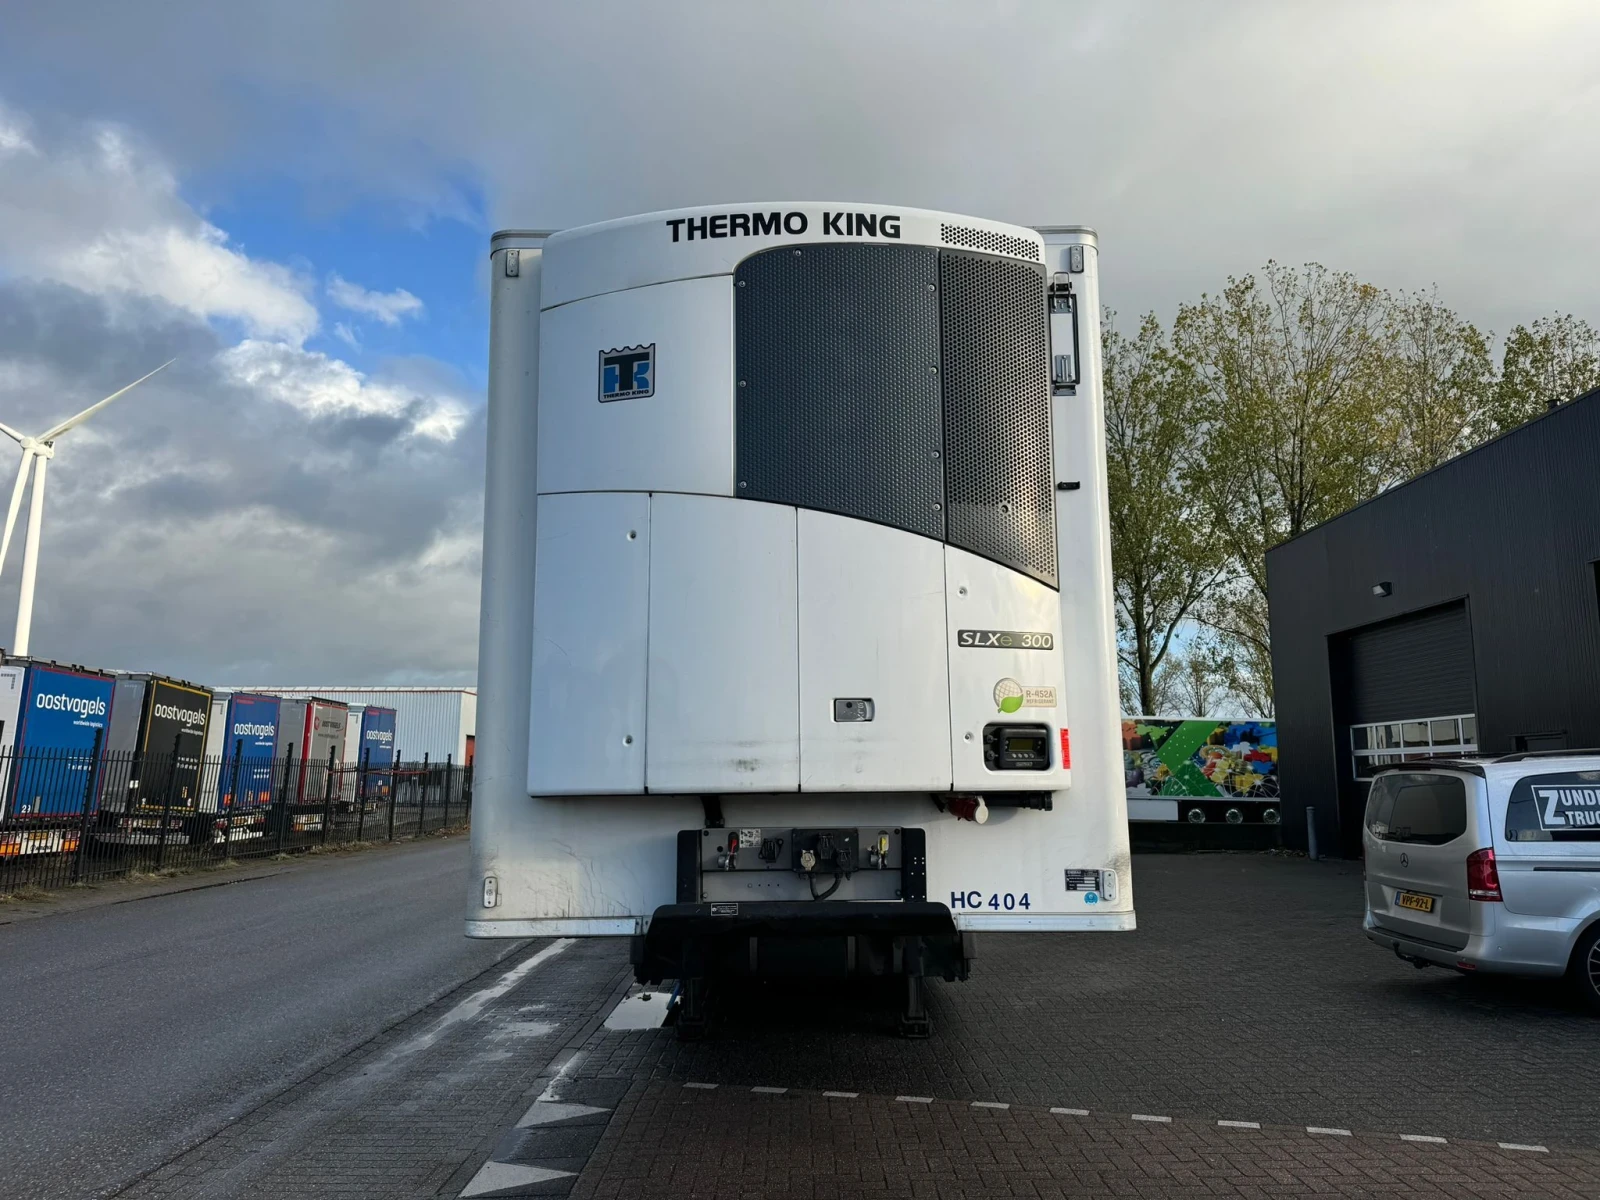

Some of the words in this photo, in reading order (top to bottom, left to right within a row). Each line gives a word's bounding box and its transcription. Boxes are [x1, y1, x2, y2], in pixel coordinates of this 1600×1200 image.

[666, 212, 808, 242] THERMO
[823, 212, 901, 239] KING
[603, 391, 631, 399] THERMO
[960, 631, 1013, 647] SLXe
[1021, 634, 1052, 648] 300
[1025, 690, 1054, 698] R-452A
[36, 693, 106, 718] oostvogels
[154, 704, 206, 727] oostvogels
[234, 722, 275, 739] oostvogels
[366, 729, 393, 743] oostvogels
[951, 891, 982, 909] HC
[988, 893, 1031, 910] 404
